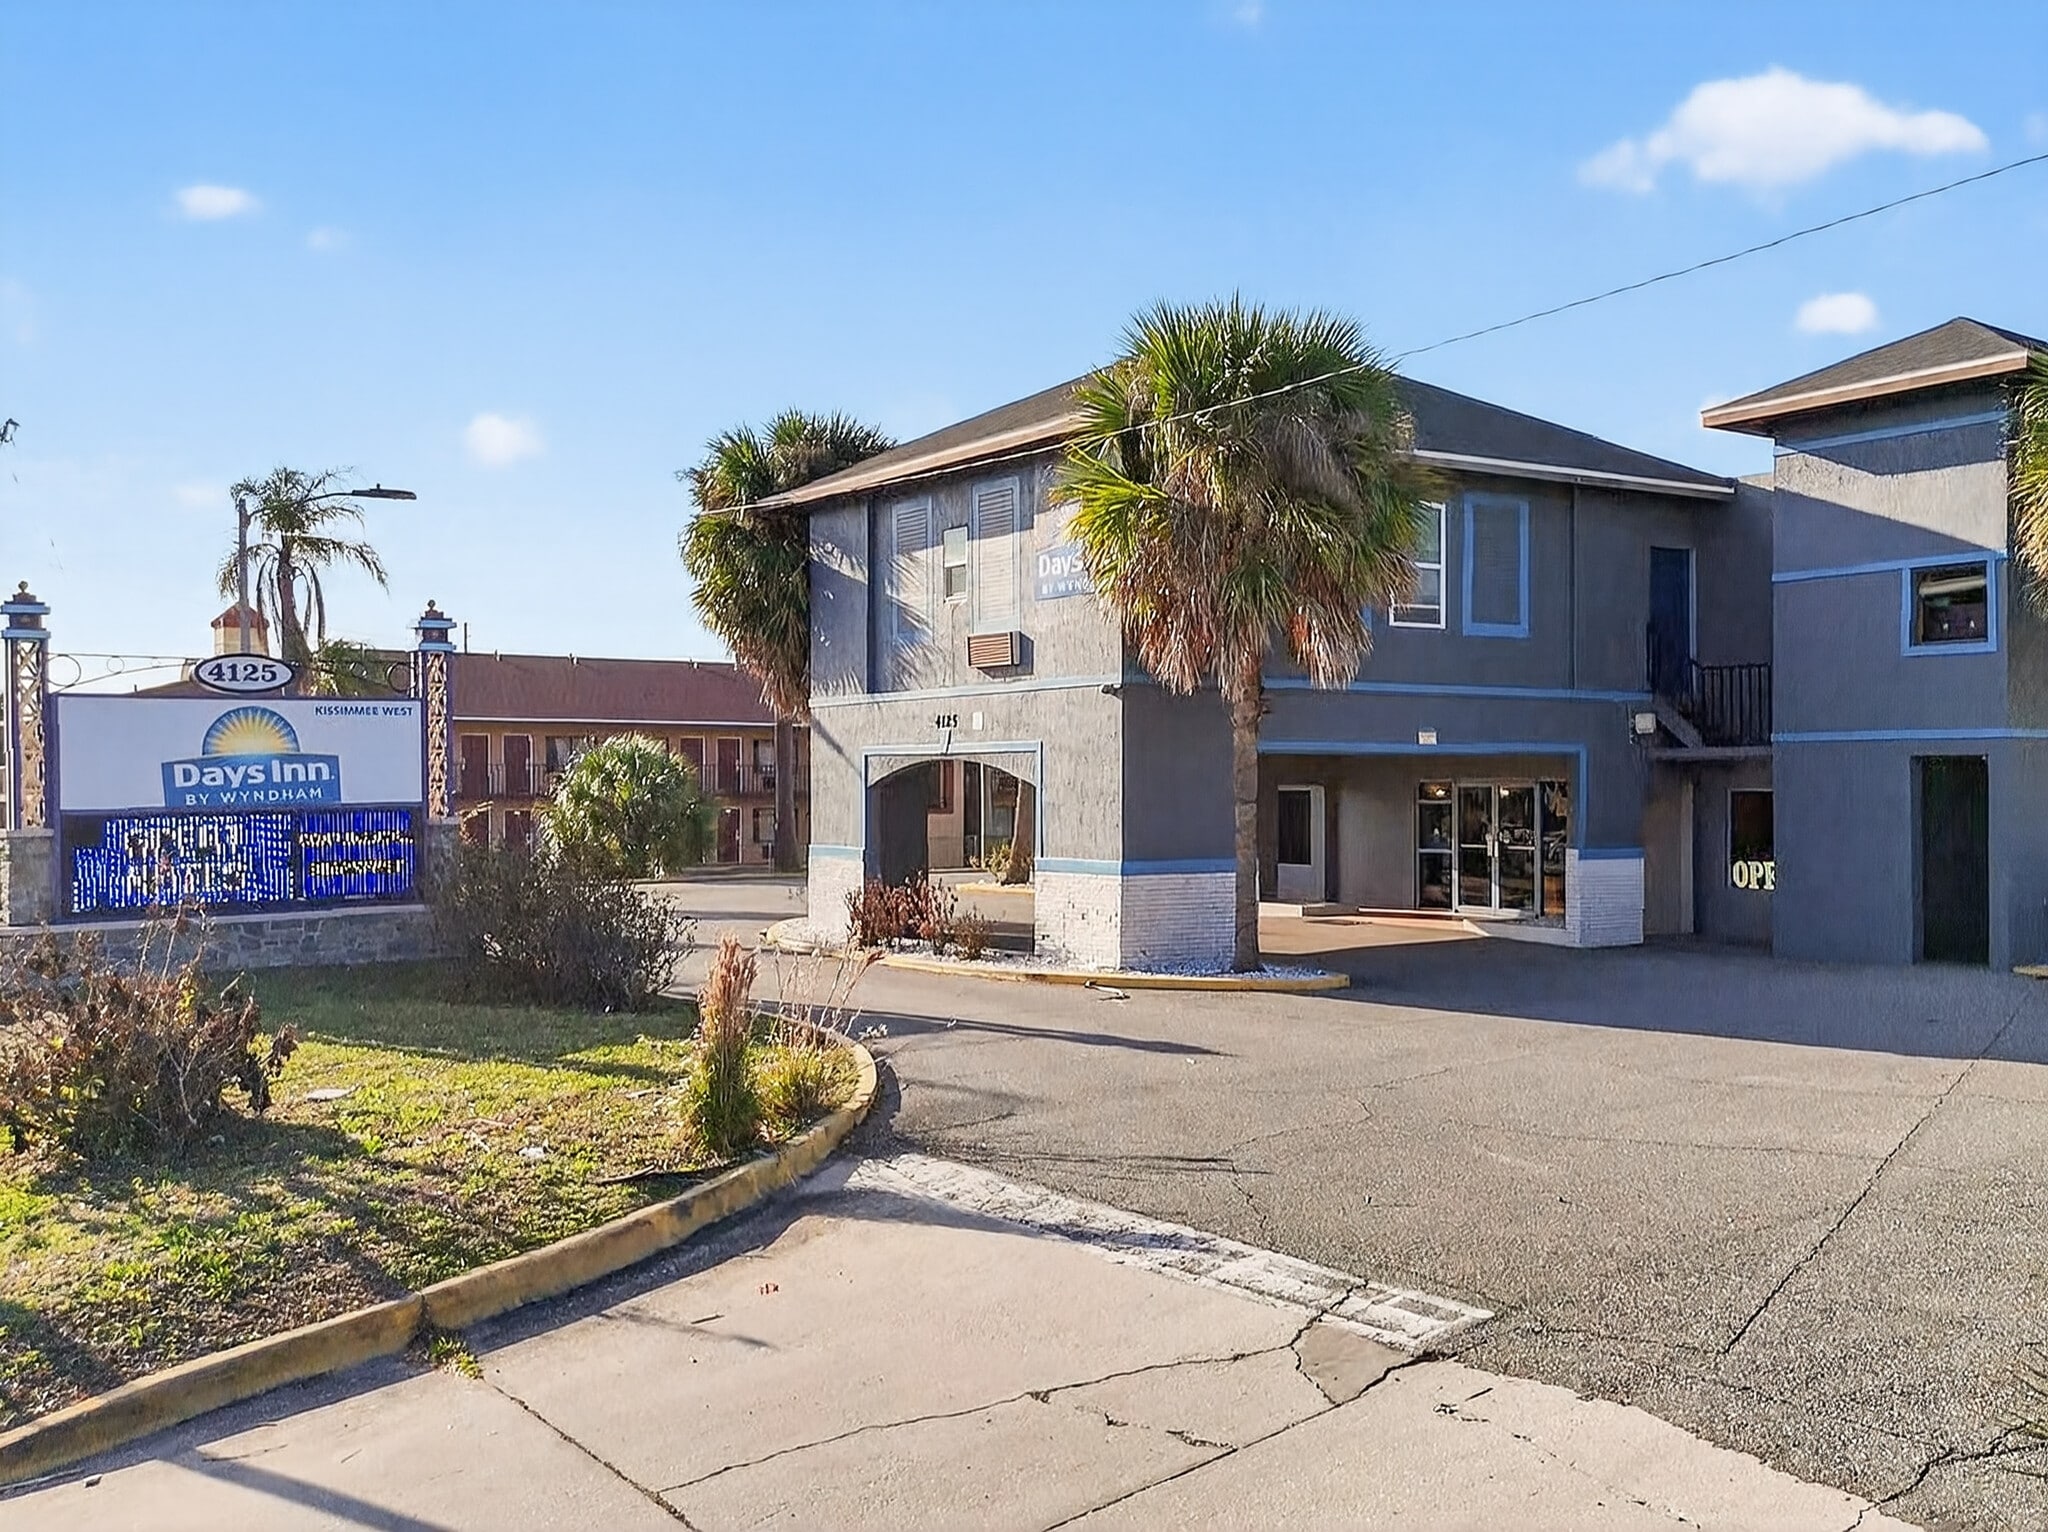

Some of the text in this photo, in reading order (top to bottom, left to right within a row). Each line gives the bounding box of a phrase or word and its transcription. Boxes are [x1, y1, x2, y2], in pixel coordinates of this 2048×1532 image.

[207, 662, 277, 682] 4125
[314, 706, 413, 716] KISSIMMEE WEST
[935, 713, 958, 729] 4125
[173, 763, 266, 788] Days
[185, 787, 323, 806] BY WYNDHAM
